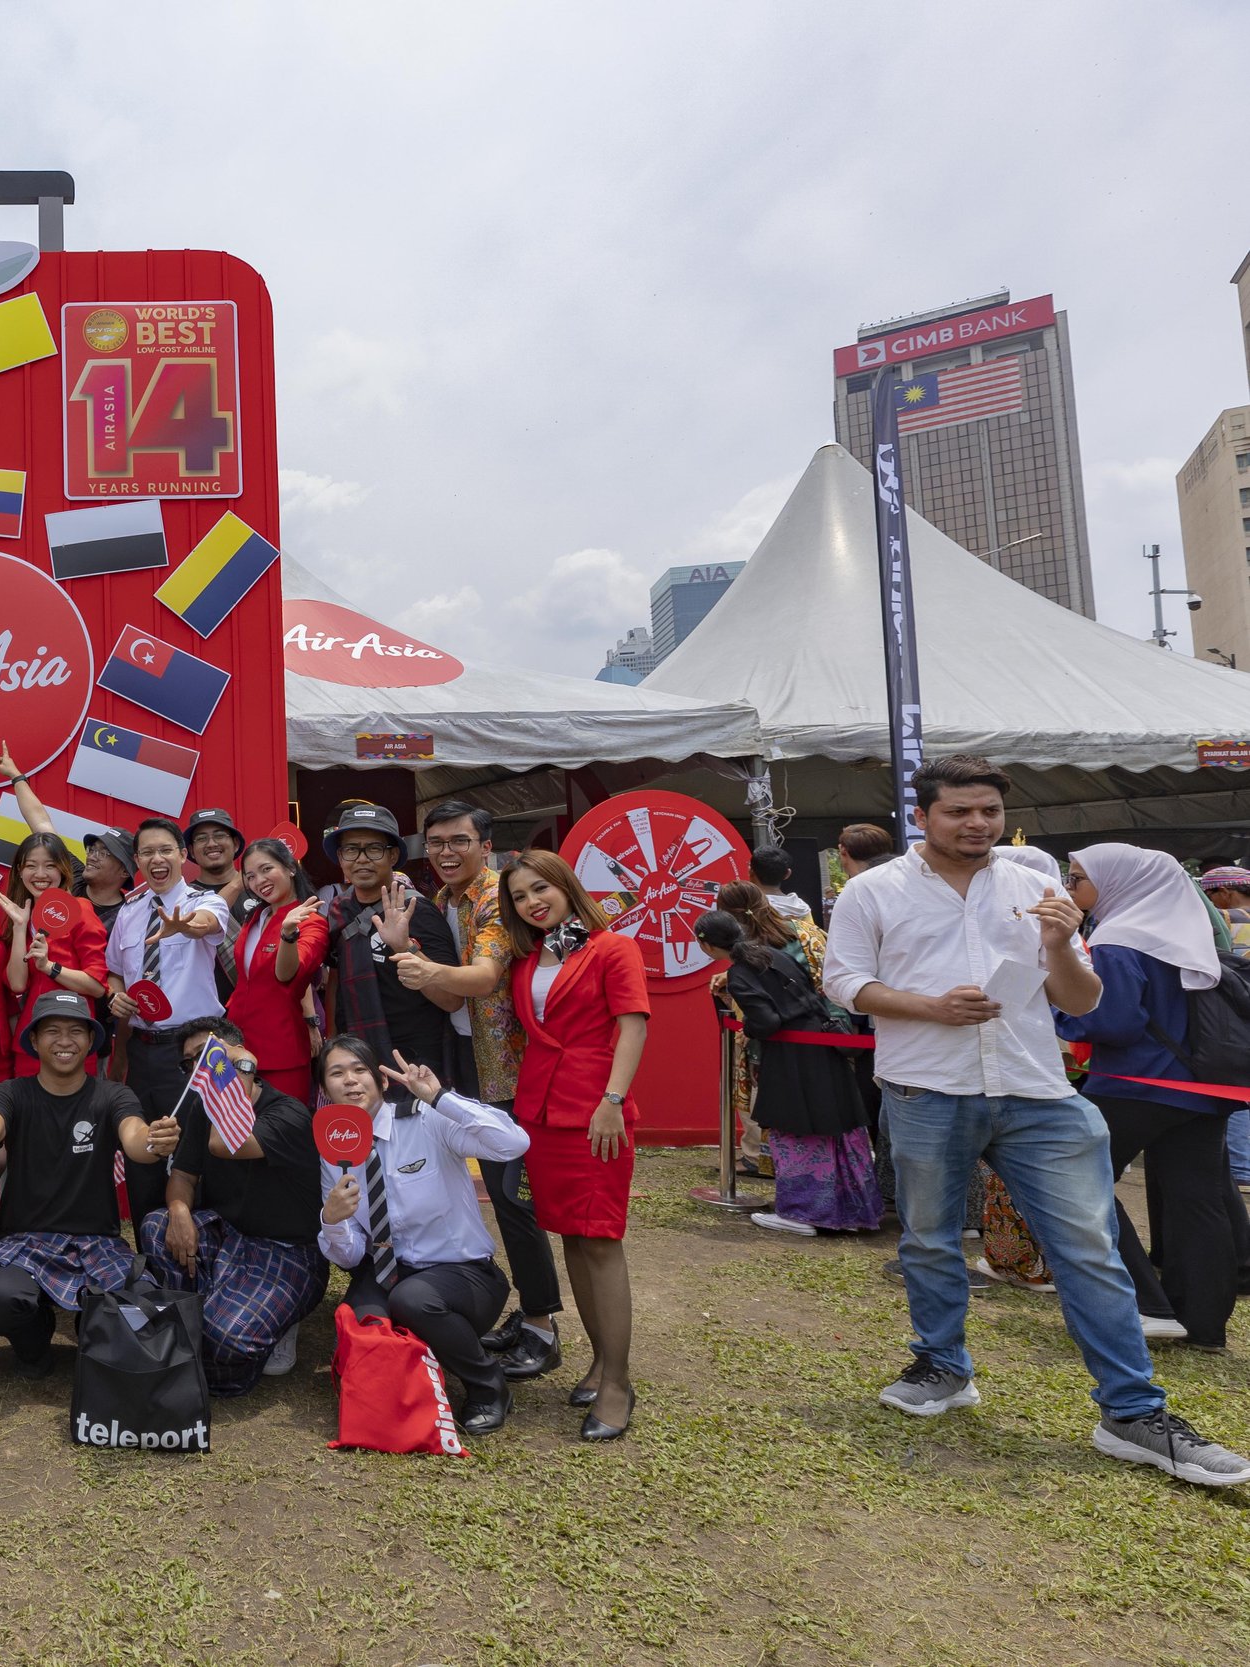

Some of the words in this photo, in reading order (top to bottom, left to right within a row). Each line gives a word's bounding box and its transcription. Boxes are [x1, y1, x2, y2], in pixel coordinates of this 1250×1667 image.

[135, 307, 216, 320] WORLD'S
[136, 322, 216, 345] BEST
[891, 328, 954, 354] CIMB
[959, 308, 1027, 339] BANK
[137, 346, 182, 354] LOW-COST
[69, 357, 234, 478] 14
[104, 385, 116, 450] AIRASIA
[89, 483, 140, 494] YEARS
[148, 481, 221, 493] RUNNING
[689, 566, 729, 582] AIA
[616, 844, 638, 861] airasia
[675, 862, 694, 877] airasia
[683, 893, 706, 904] airasia
[76, 1412, 208, 1449] teleport
